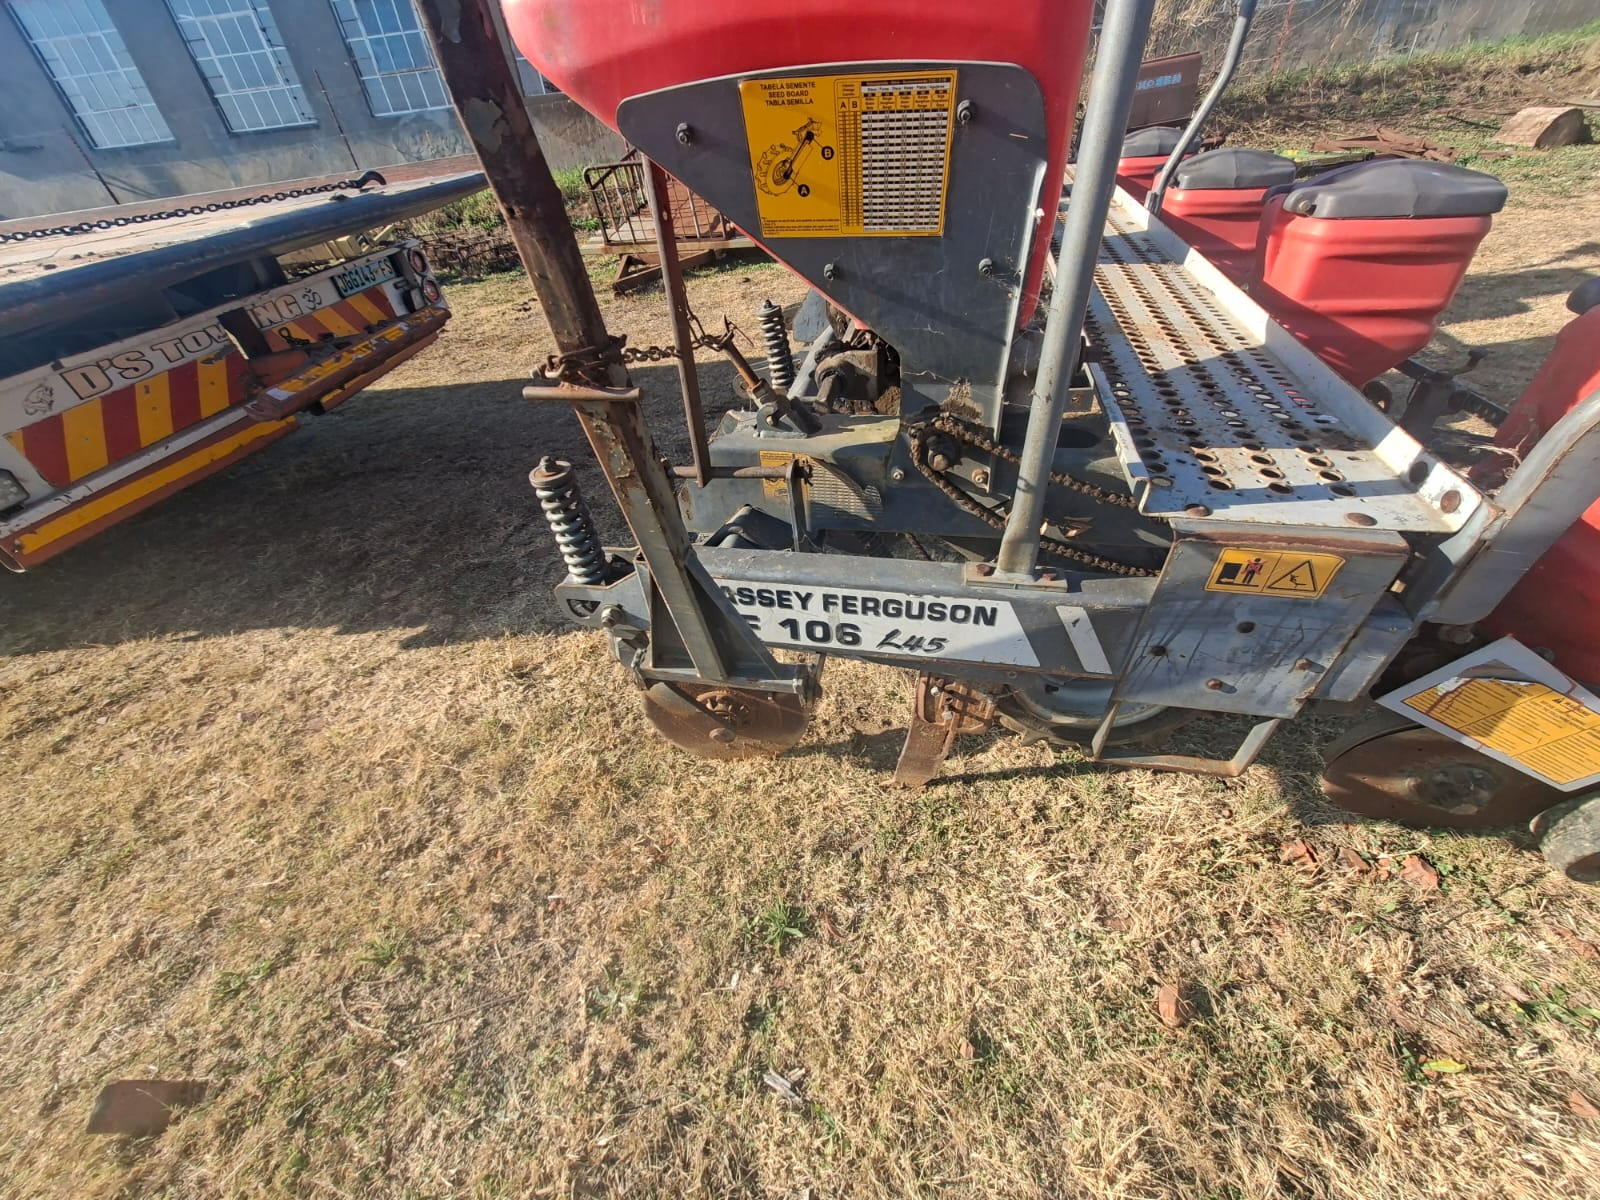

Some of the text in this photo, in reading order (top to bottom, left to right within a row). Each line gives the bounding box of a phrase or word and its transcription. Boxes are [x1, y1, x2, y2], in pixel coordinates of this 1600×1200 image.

[851, 101, 858, 109] B
[377, 258, 394, 277] FS
[60, 350, 154, 400] D'S
[720, 585, 998, 627] ASSEY FERGUSON
[778, 618, 862, 647] 106
[876, 628, 950, 654] L45
